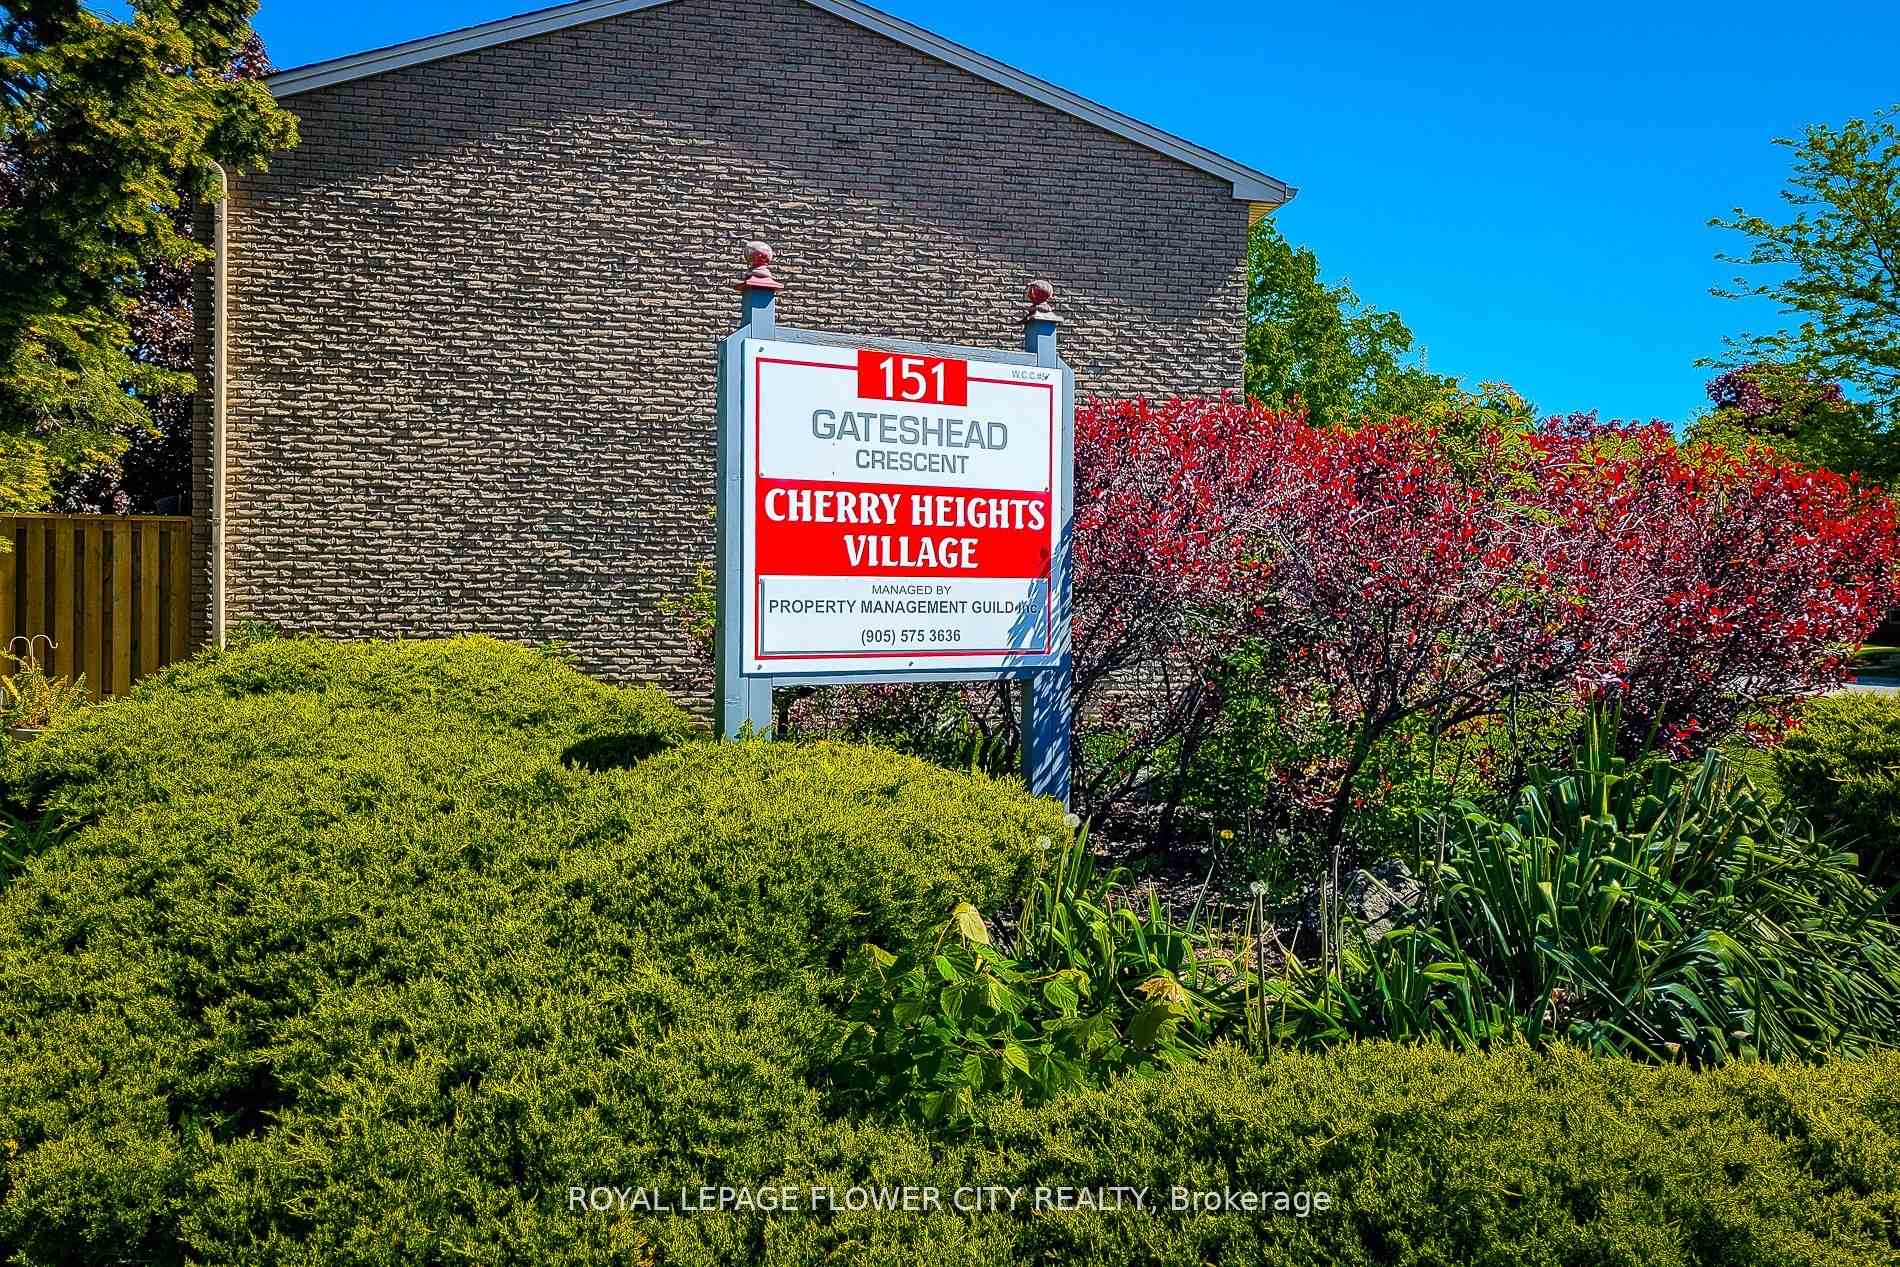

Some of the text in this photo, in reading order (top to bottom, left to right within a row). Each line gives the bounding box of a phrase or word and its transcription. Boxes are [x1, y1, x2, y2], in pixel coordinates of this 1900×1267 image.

[879, 356, 945, 402] 151
[812, 409, 1008, 451] GATESHEAD
[856, 449, 969, 474] CRESCENT
[764, 488, 1045, 531] CHERRY HEIGHTS
[843, 535, 978, 569] VILLAGE
[872, 584, 952, 596] MANAGED BY
[769, 599, 856, 614] PROPERTY
[861, 600, 967, 614] MANAGEMENT
[971, 600, 1014, 614] GUILD
[861, 629, 961, 646] (905) 575 3636
